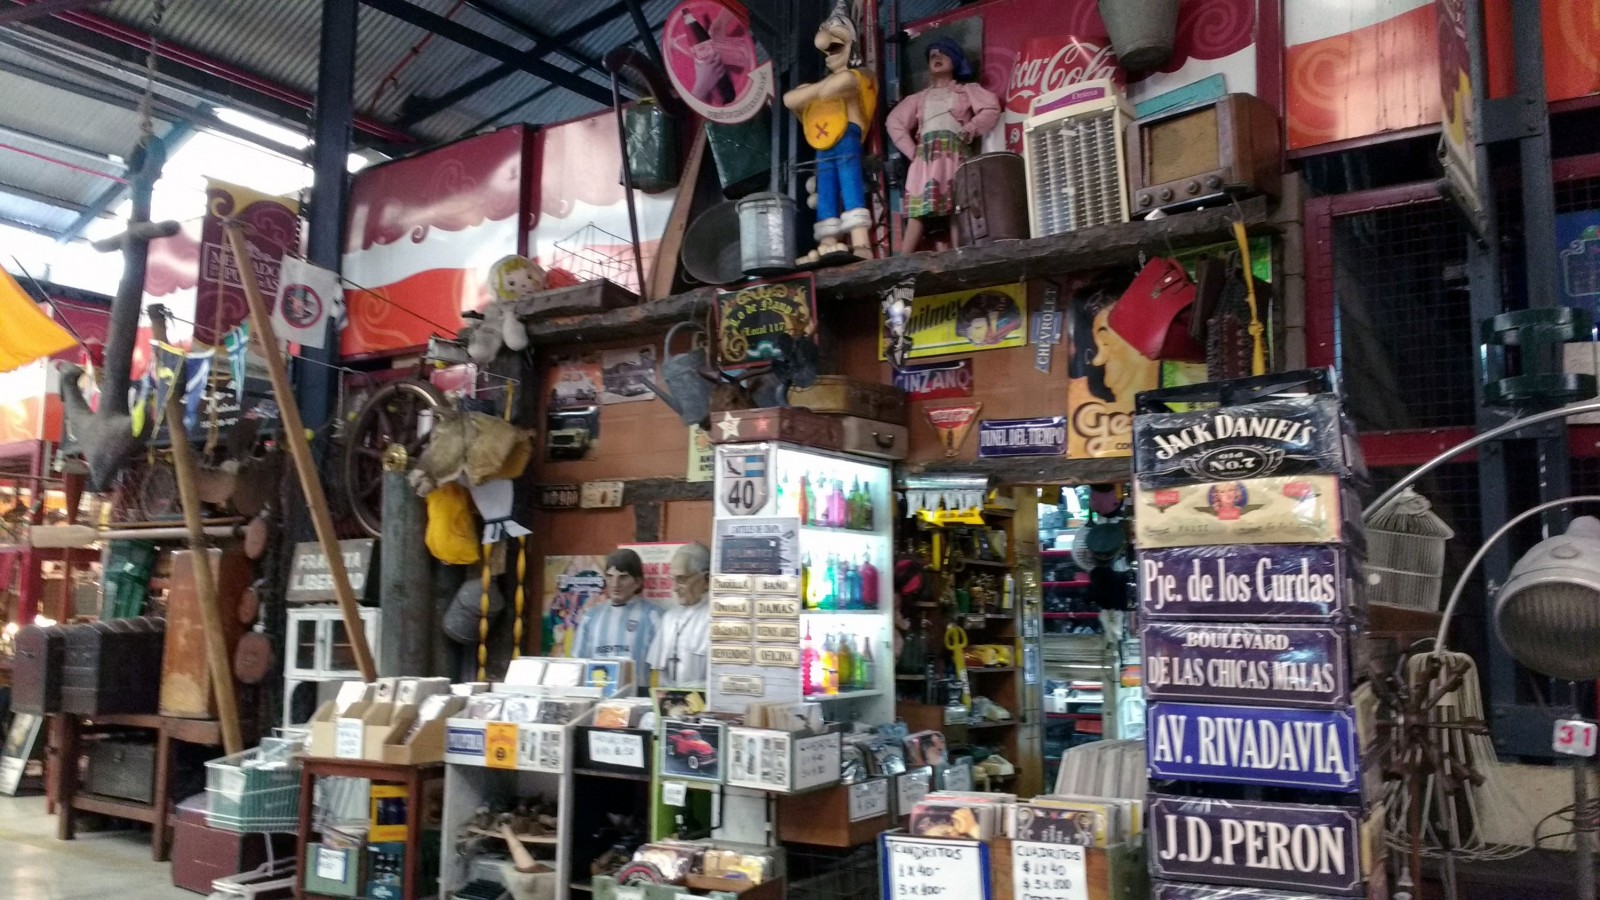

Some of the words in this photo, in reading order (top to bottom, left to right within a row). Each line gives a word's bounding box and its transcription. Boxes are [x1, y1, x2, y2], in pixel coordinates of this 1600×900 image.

[1037, 287, 1057, 365] CHEVROLET
[894, 368, 972, 393] CINZANO
[1153, 422, 1215, 460] JACK
[1214, 413, 1317, 446] DANIEL'S
[728, 481, 754, 509] 40
[1144, 559, 1183, 609] Pje.
[1187, 558, 1213, 602] de
[1217, 558, 1251, 602] los
[1256, 557, 1336, 603] Curdas
[758, 603, 794, 613] DAMAS
[1148, 656, 1170, 684] DE
[1173, 657, 1204, 686] LAS
[1207, 658, 1270, 690] CHICAS
[1272, 661, 1335, 693] MALAS
[1154, 714, 1193, 764] AV.
[1198, 716, 1347, 774] RIVADAVIA
[1559, 726, 1591, 747] 31
[1016, 845, 1082, 861] CUADRITOS
[1160, 814, 1345, 875] J.D.PERON
